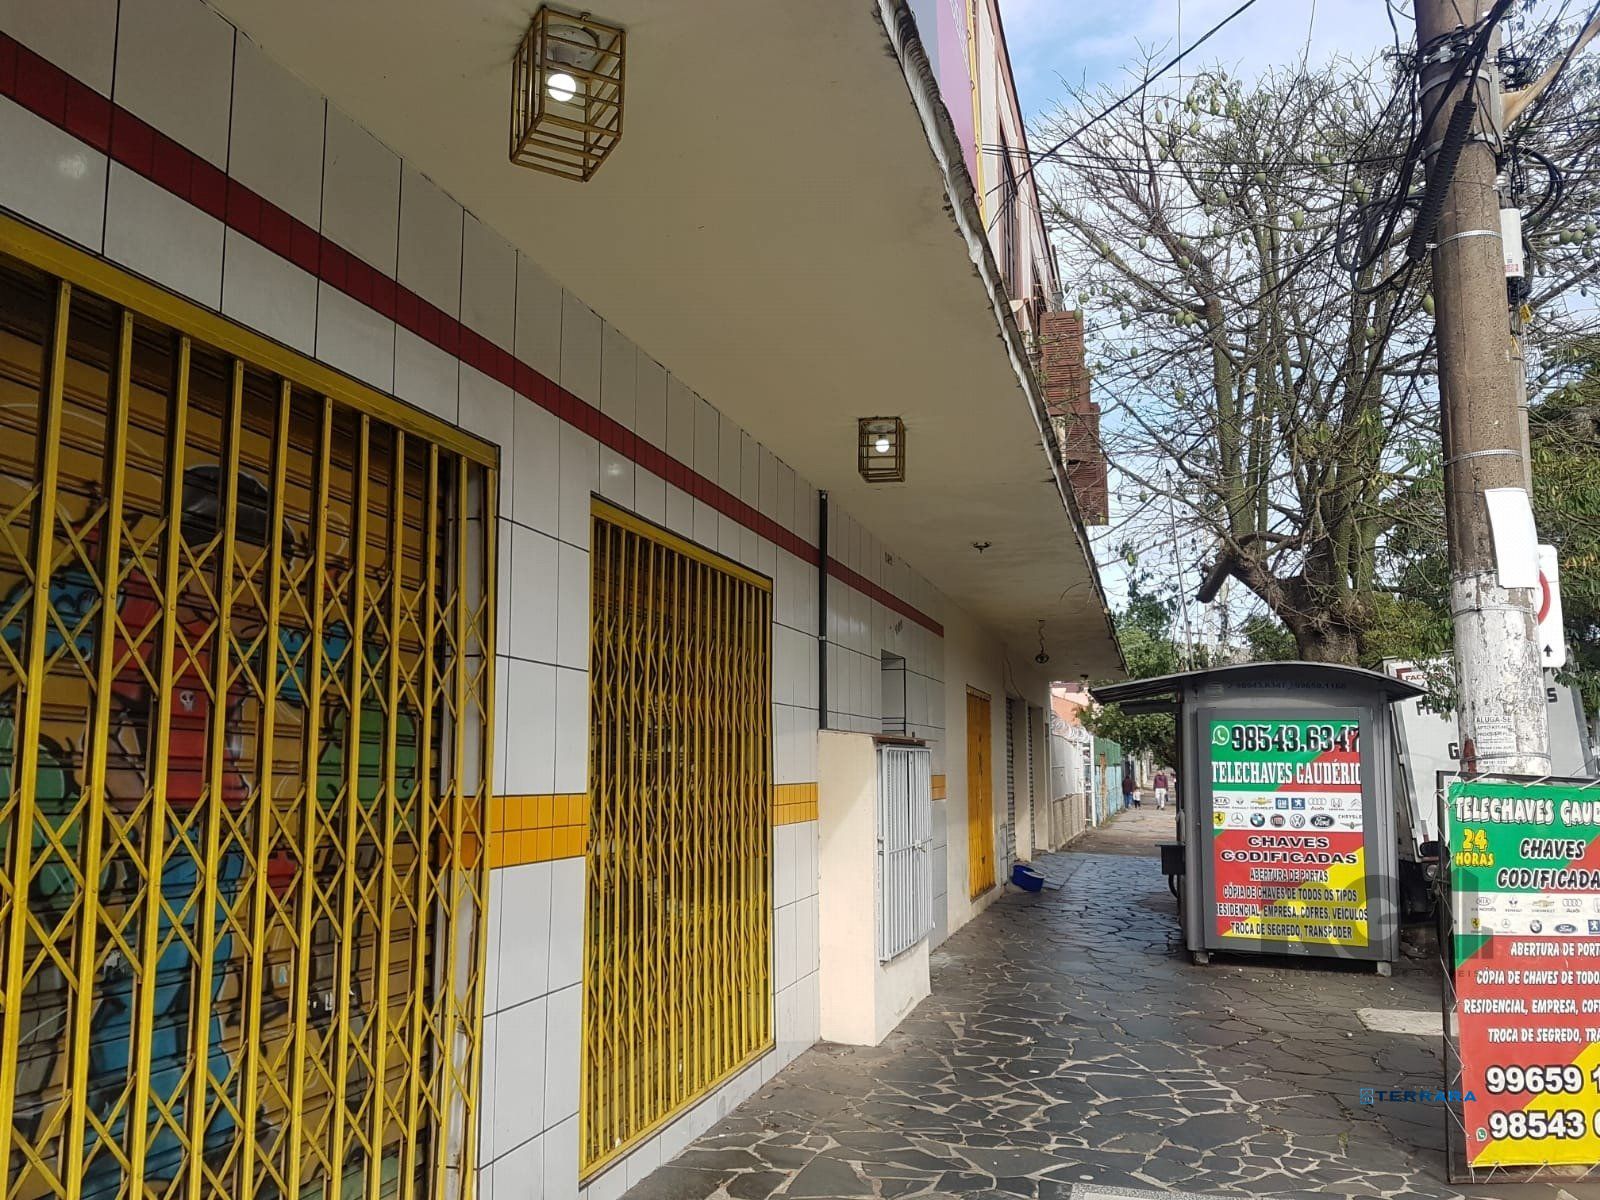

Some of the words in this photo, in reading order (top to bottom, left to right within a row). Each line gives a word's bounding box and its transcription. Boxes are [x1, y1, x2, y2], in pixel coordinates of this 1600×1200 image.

[1232, 724, 1360, 753] 98543.6347
[1211, 761, 1293, 784] TELECHAVES
[1455, 796, 1555, 824] TELECHAVES
[1248, 836, 1329, 848] CHAVES
[1463, 828, 1488, 852] 24
[1520, 838, 1586, 860] CHAVES
[1221, 851, 1357, 864] CODIFICADAS
[1455, 852, 1495, 868] HORAS
[1250, 868, 1287, 881] ABERTURA
[1289, 869, 1300, 882] DE
[1301, 870, 1328, 882] PORTAS
[1497, 867, 1600, 889] CODIFICADA
[1223, 883, 1246, 899] CÓPIA
[1246, 885, 1257, 899] DE
[1257, 886, 1285, 900] CHAVES
[1287, 887, 1297, 901] DE
[1298, 888, 1322, 901] TODOS
[1324, 889, 1334, 901] OS
[1336, 889, 1357, 902] TIPOS
[1301, 907, 1331, 921] COFRES,
[1231, 922, 1254, 935] TROCA
[1256, 923, 1266, 935] DE
[1267, 923, 1303, 938] SEGREDO,
[1304, 925, 1352, 939] TRANSPODER
[1510, 942, 1562, 957] ABERTURA
[1562, 943, 1575, 957] DE
[1476, 967, 1505, 985] CÓPIA
[1508, 971, 1520, 985] DE
[1523, 970, 1558, 985] CHAVES
[1561, 971, 1574, 985] DE
[1463, 999, 1529, 1015] RESIDENCIAL,
[1532, 999, 1579, 1015] EMPRESA,
[1488, 1028, 1519, 1043] TROCA
[1521, 1029, 1534, 1043] DE
[1536, 1028, 1582, 1043] SEGREDO,
[1486, 1064, 1584, 1094] 99659
[1488, 1109, 1587, 1140] 98543
